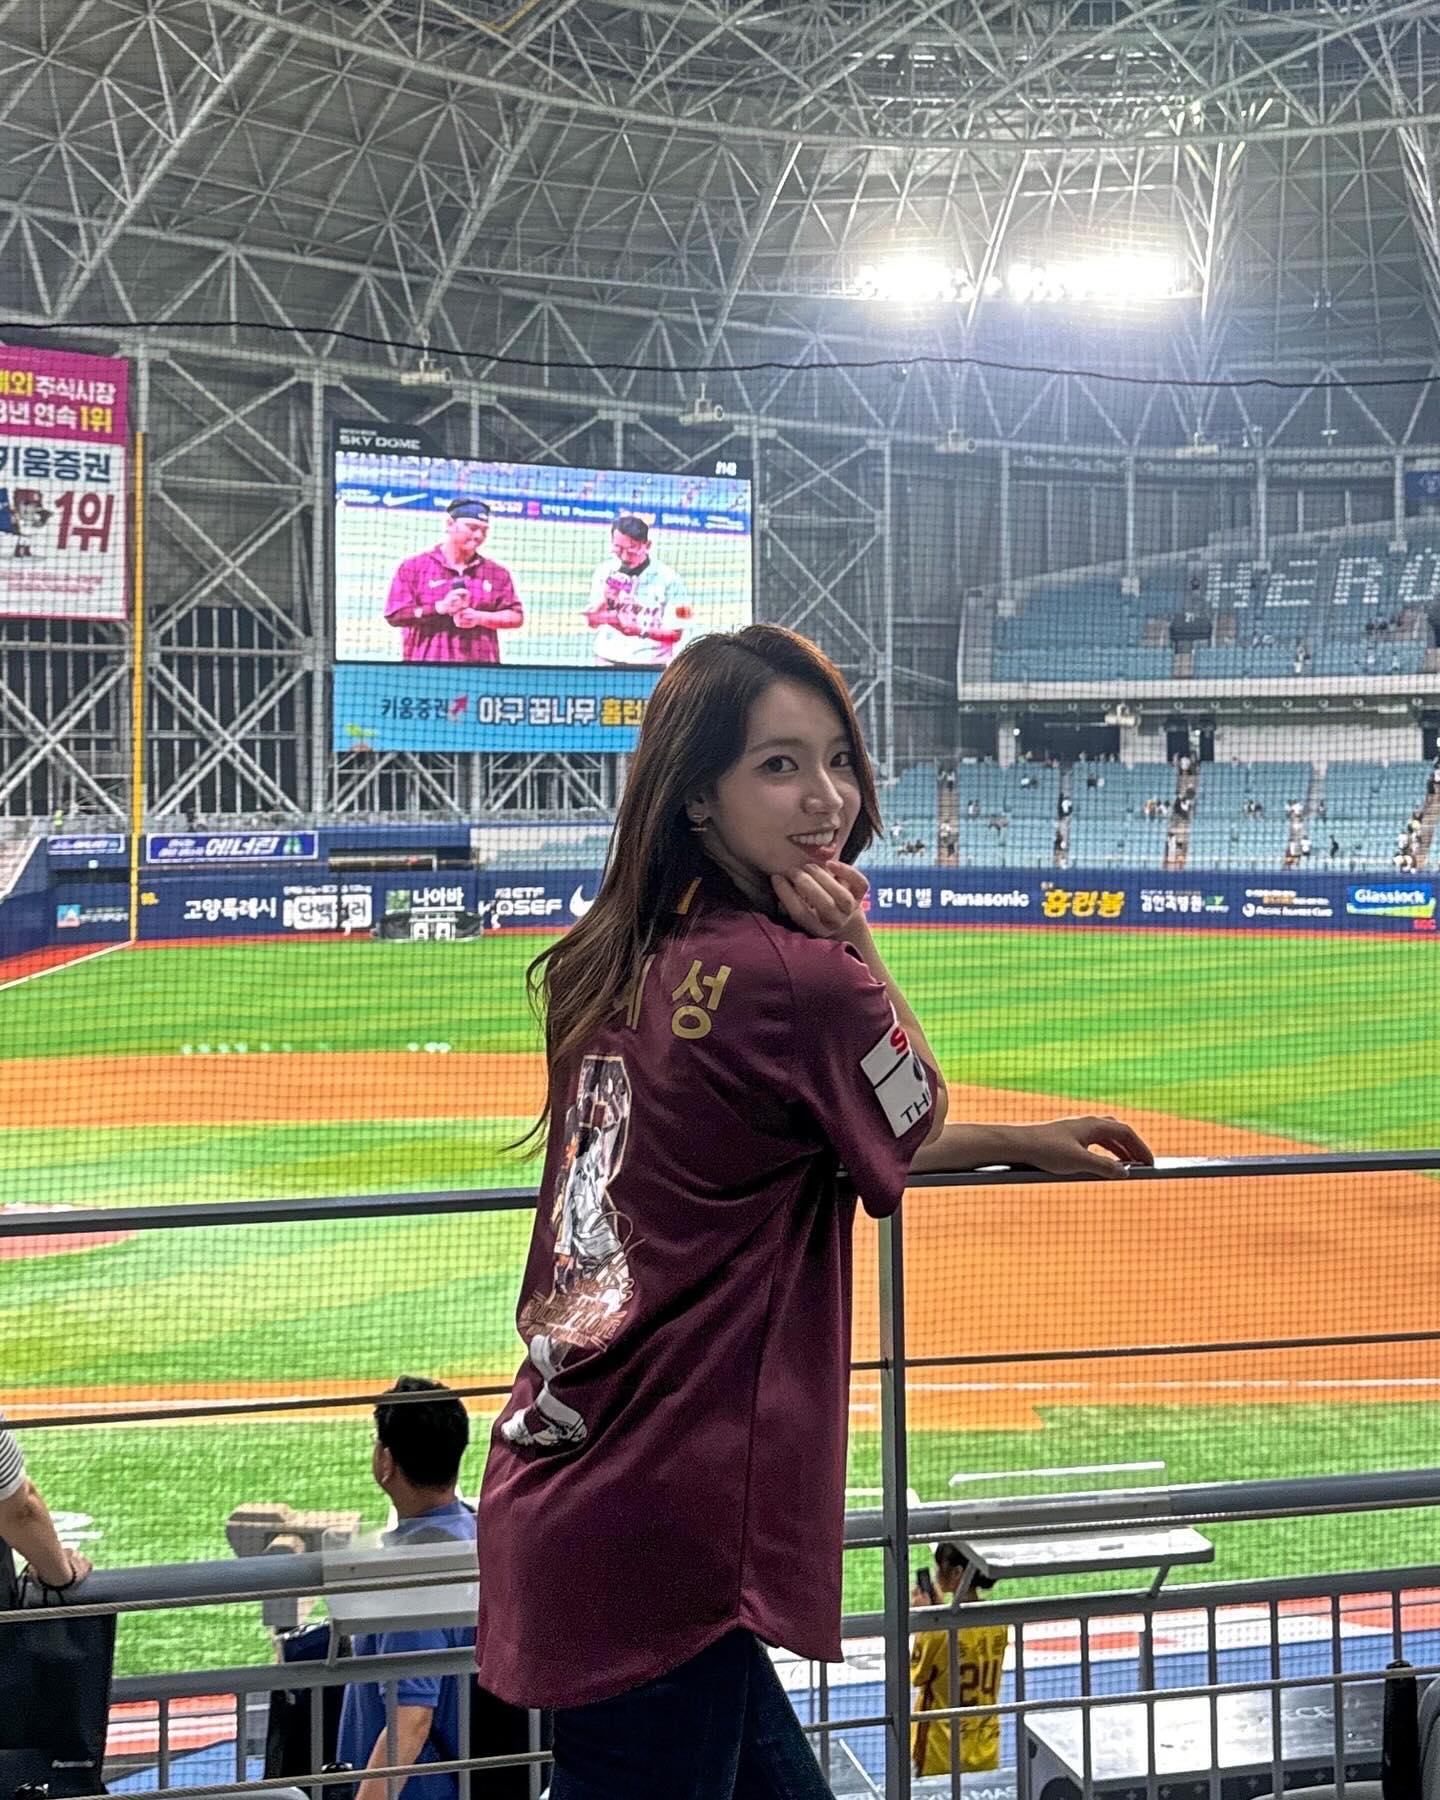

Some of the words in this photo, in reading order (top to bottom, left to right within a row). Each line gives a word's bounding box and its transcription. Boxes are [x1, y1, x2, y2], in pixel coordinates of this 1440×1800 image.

[35, 375, 117, 405] 주식시장
[34, 402, 77, 430] 연속
[80, 405, 112, 433] 1위
[339, 434, 374, 447] SKY
[375, 436, 421, 450] DOME
[0, 446, 111, 483] 키움증권
[55, 490, 114, 552] 1위
[479, 695, 525, 725] 야구
[529, 695, 595, 725] 꿈나무
[601, 697, 650, 725] 홈런
[184, 897, 276, 922] 고양특례시
[940, 889, 1030, 908] Panasonic
[1354, 888, 1426, 905] Glasslock
[899, 1090, 931, 1123] TH
[960, 1660, 999, 1708] 24
